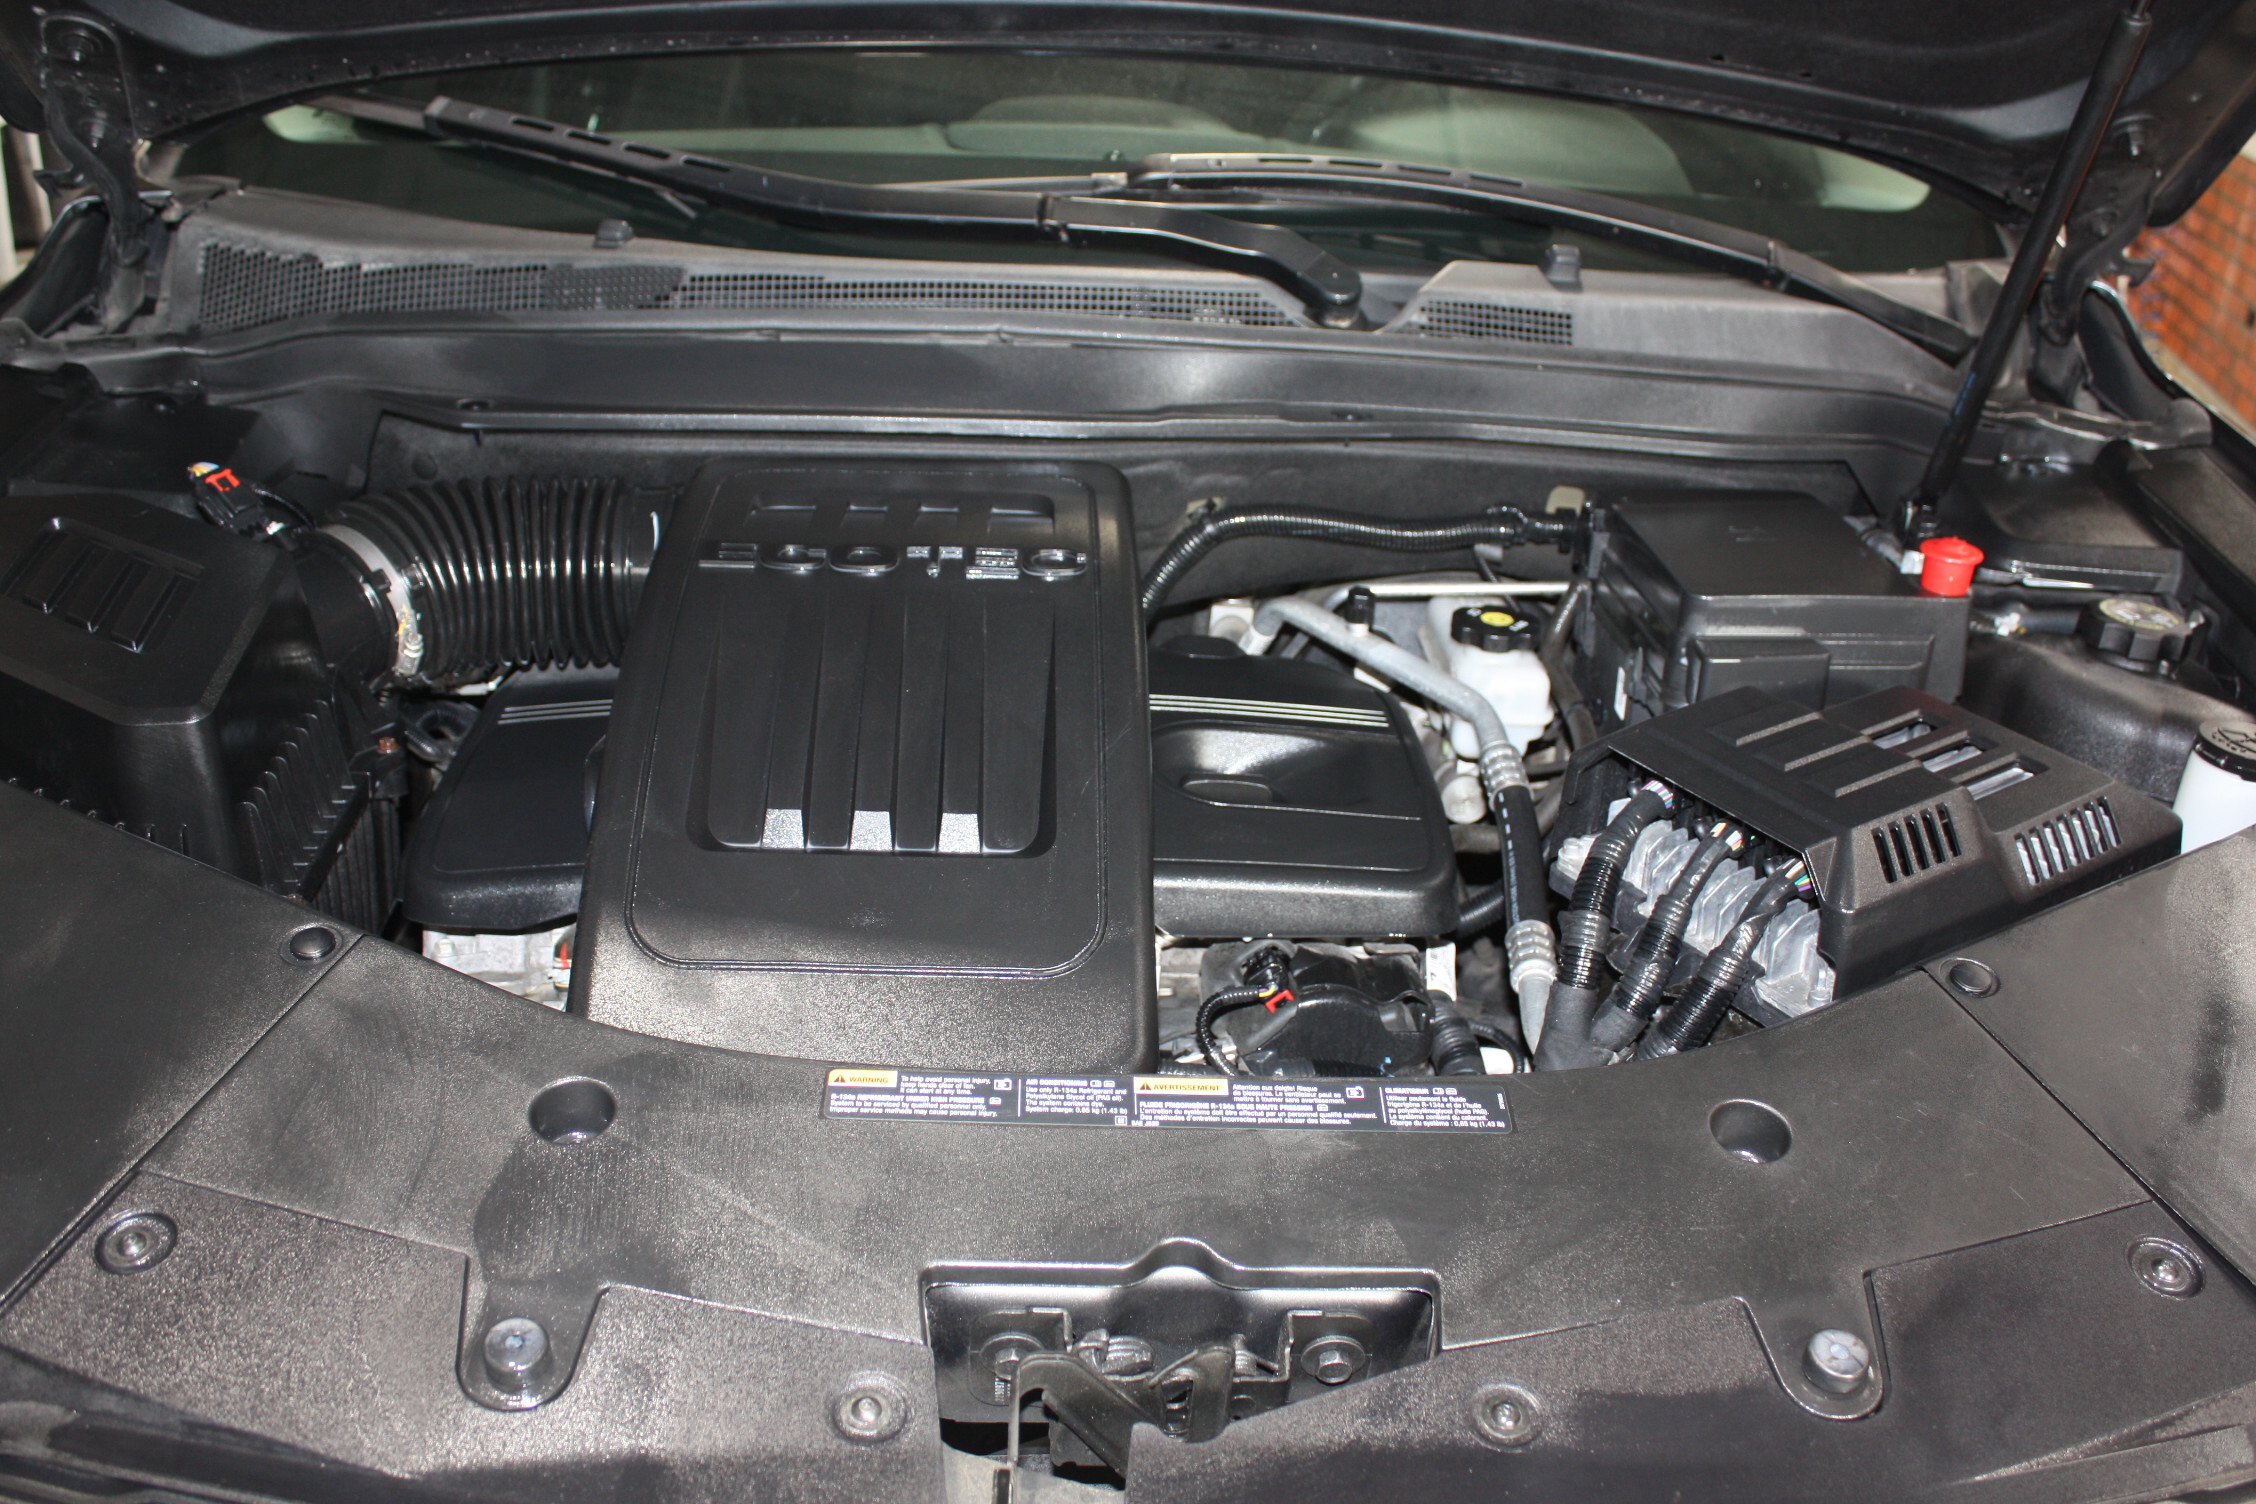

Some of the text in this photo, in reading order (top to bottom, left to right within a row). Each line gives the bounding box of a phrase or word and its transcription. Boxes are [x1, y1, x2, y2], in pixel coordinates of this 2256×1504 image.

[699, 542, 1088, 582] ECOTEC
[910, 1075, 924, 1083] help
[1153, 1083, 1220, 1091] AVERTISSEMENT
[1297, 1085, 1318, 1093] Risque
[1079, 1087, 1114, 1096] Refrigerant
[1066, 1093, 1085, 1101] Glycol
[830, 1100, 854, 1108] System
[1039, 1099, 1062, 1107] system
[830, 1106, 859, 1114] Improper
[1026, 1105, 1049, 1113] System
[1470, 1121, 1478, 1129] kg
